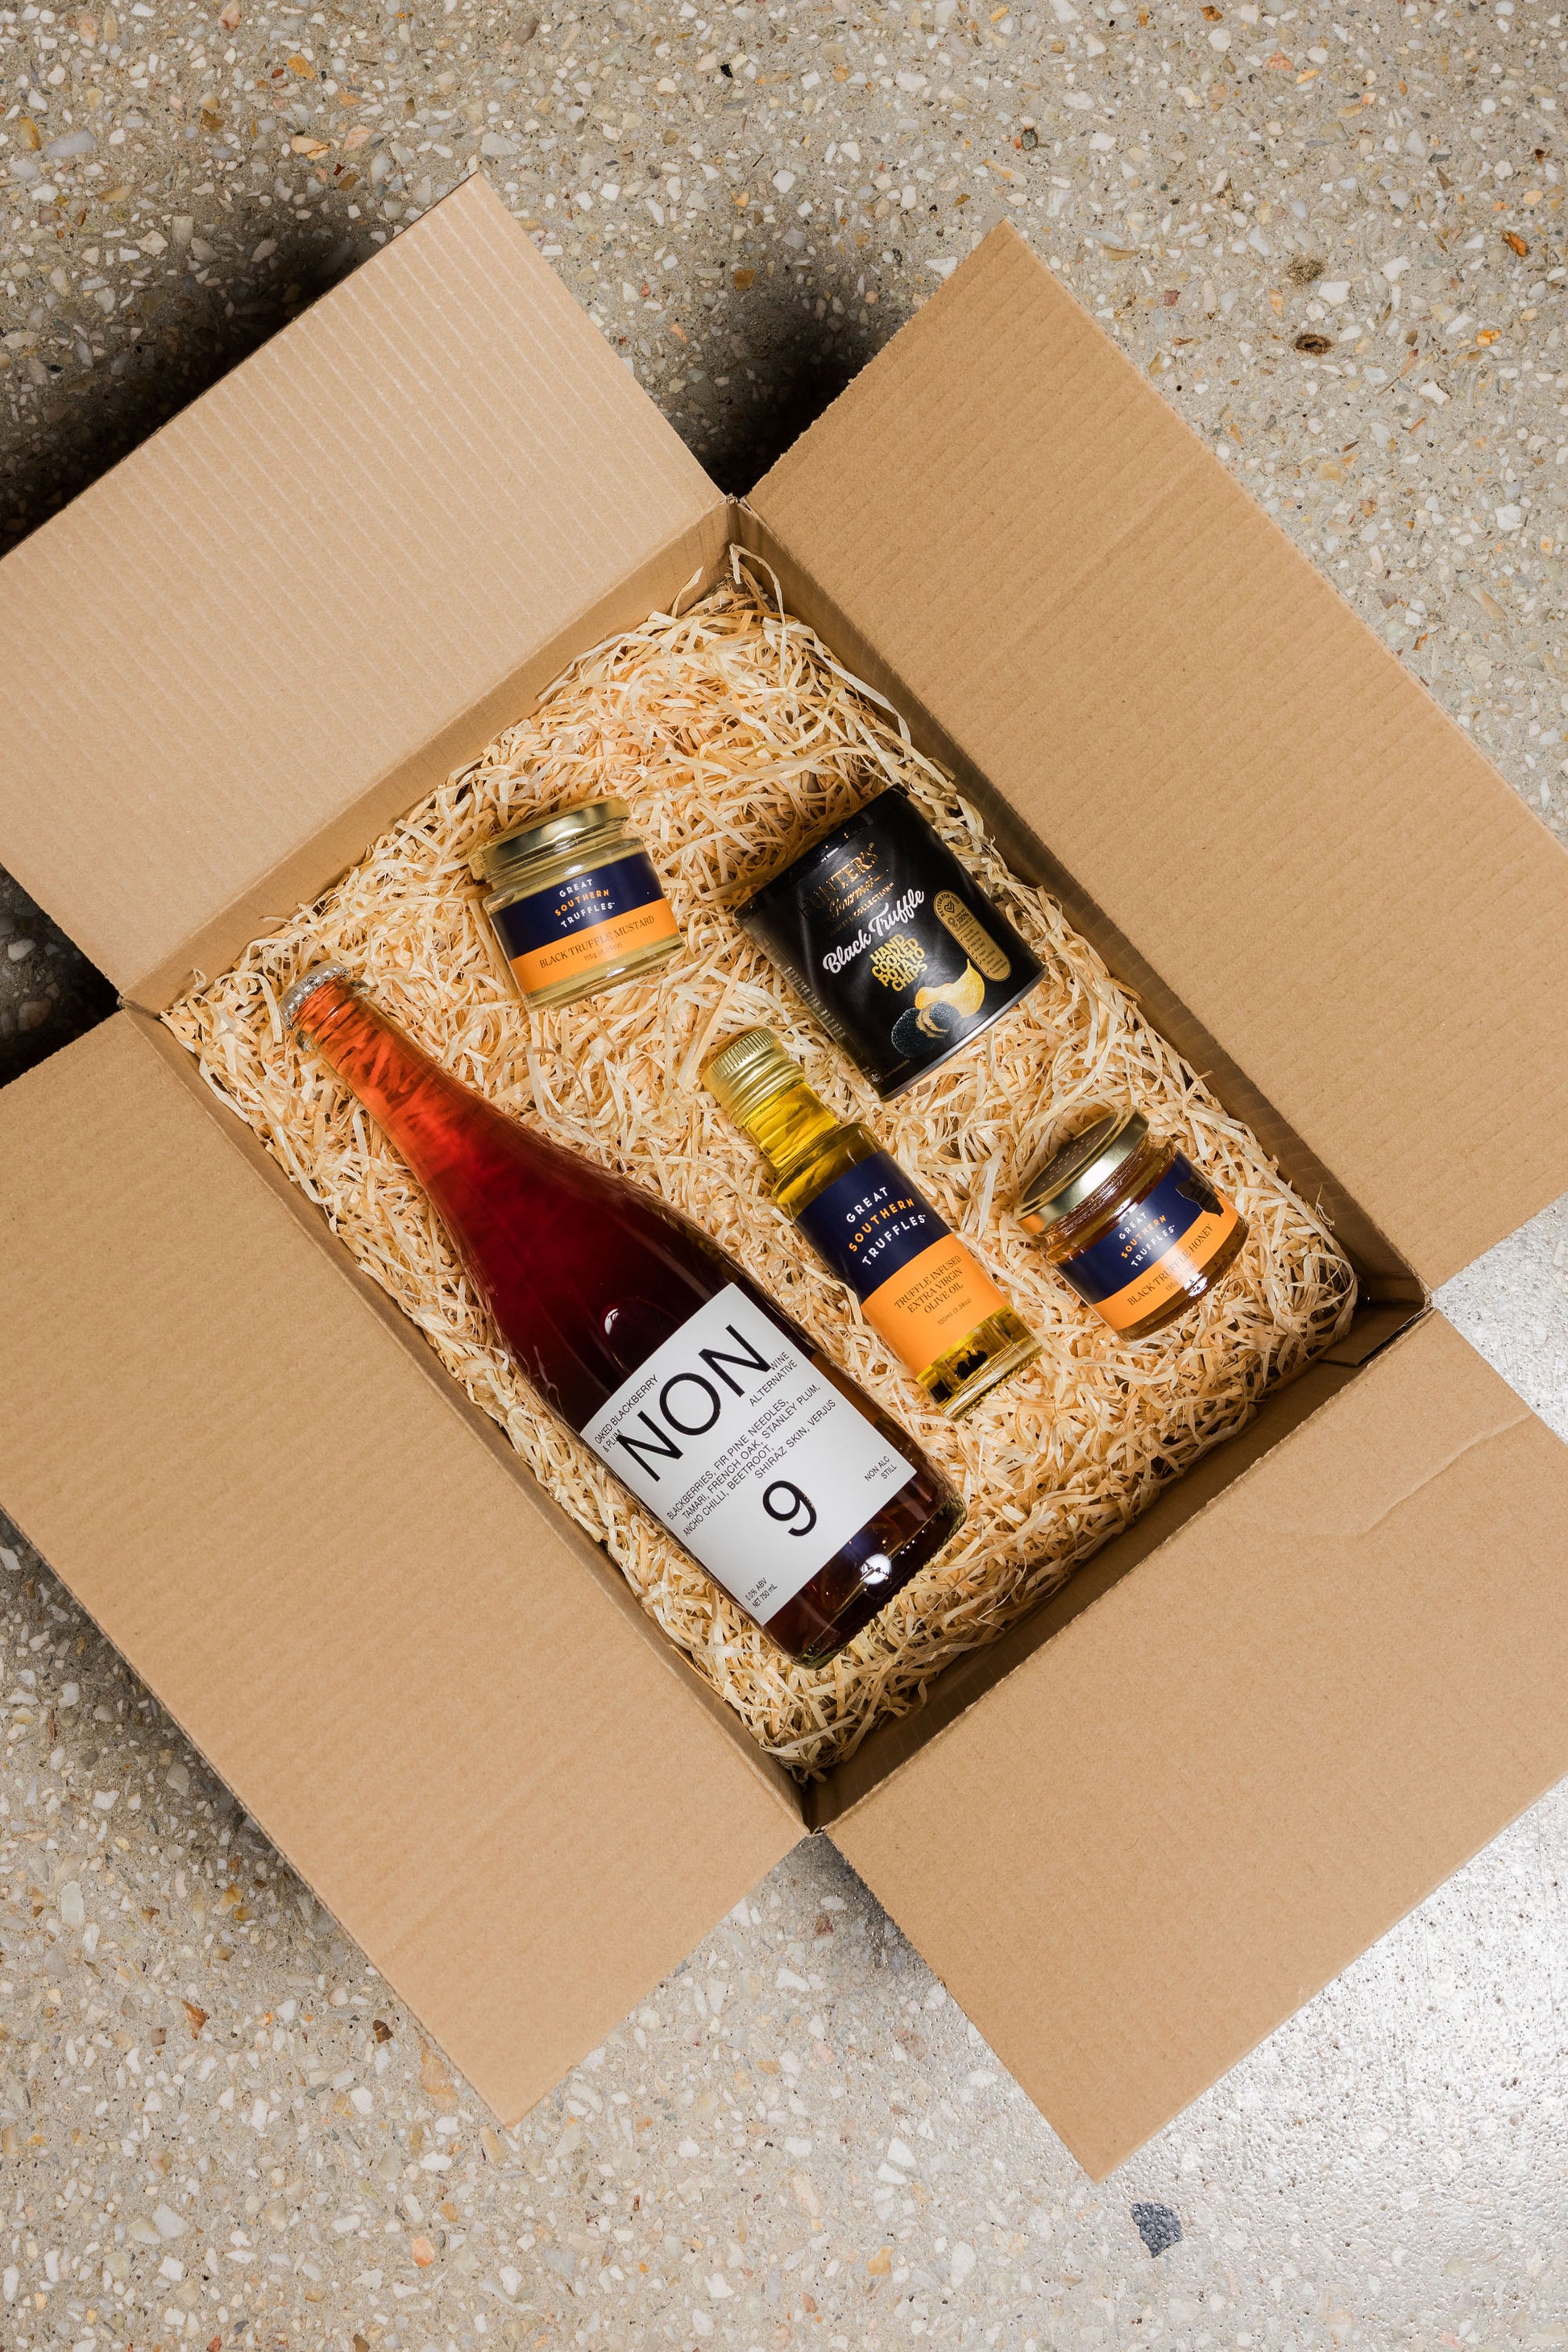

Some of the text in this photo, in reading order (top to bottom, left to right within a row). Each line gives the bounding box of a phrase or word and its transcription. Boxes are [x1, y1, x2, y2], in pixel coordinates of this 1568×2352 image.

[554, 890, 609, 916] SOUTHERN
[559, 879, 592, 897] GREAT
[854, 885, 891, 916] COLLECTION
[951, 894, 960, 905] YOU
[539, 915, 655, 969] BLACK TRUFFLE MUSTARD
[823, 889, 924, 973] Black Truffle
[870, 934, 905, 964] HAND
[871, 938, 919, 977] COOKED
[878, 948, 925, 987] POTATO
[892, 960, 927, 992] CHIPS
[846, 1187, 888, 1222] GREAT
[848, 1198, 915, 1252] SOUTHERN
[1118, 1212, 1147, 1239] GREAT
[1121, 1215, 1166, 1259] SOUTHERN
[894, 1255, 961, 1309] TRUFFLE INFUSED
[1127, 1284, 1155, 1305] BLACK
[1153, 1250, 1191, 1285] TRUFFLE
[1188, 1223, 1213, 1252] HONEY
[907, 1267, 963, 1313] EXTRA VIRGIN
[923, 1282, 964, 1313] OLIVE OIL
[770, 1351, 790, 1371] WINE
[749, 1359, 798, 1407] ALTERNATIVE
[594, 1374, 658, 1444] OAKED BLACKBERRY
[616, 1324, 771, 1482] NON
[602, 1429, 624, 1453] & PLUM
[682, 1383, 820, 1519] TAMARI, FRENCH OAK, STANLEY PLUM,
[754, 1399, 836, 1479] SHIRAZ SKIN, VERJUS
[666, 1399, 790, 1520] BLACKBERRIES, FIR PINE NEEDLES,
[864, 1455, 890, 1482] NON ALC
[881, 1464, 898, 1479] STILL
[682, 1444, 774, 1537] ANCHO CHILLI, BEETROOT,
[762, 1480, 817, 1537] 9
[751, 1583, 778, 1609] NET 750 mL
[755, 1577, 767, 1591] ABV
